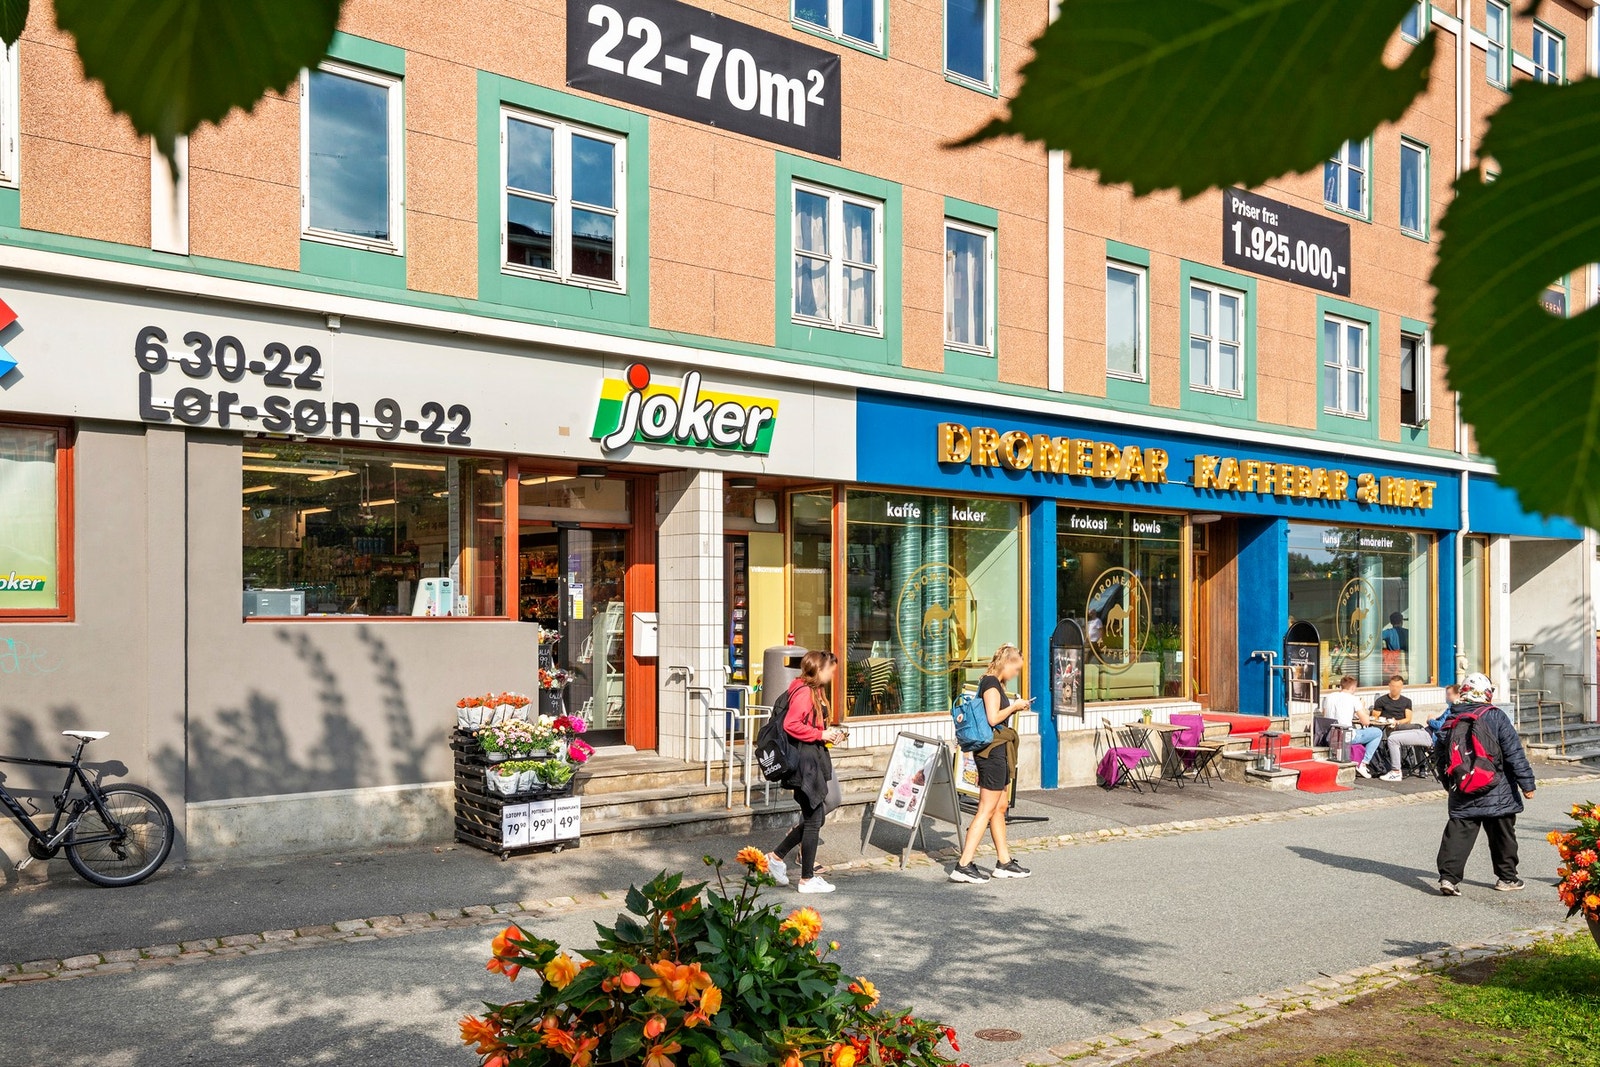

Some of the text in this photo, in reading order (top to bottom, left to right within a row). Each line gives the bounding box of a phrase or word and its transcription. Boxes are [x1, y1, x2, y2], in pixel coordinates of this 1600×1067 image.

[1232, 197, 1279, 227] Priser fra:
[1231, 221, 1346, 288] 1.925.000,-
[180, 331, 323, 389] 30-22
[139, 372, 472, 445] Lør-søn 9-22
[601, 363, 774, 451] joker
[937, 422, 1437, 509] DROMEDAR KAFFEBAR & MAT
[886, 501, 921, 519] kaffe
[952, 506, 986, 522] kaker
[1071, 514, 1108, 531] frokost
[1132, 518, 1161, 534] bowls
[1322, 531, 1394, 548] lunsj småretter
[0, 571, 42, 590] oker
[764, 763, 782, 776] adidas
